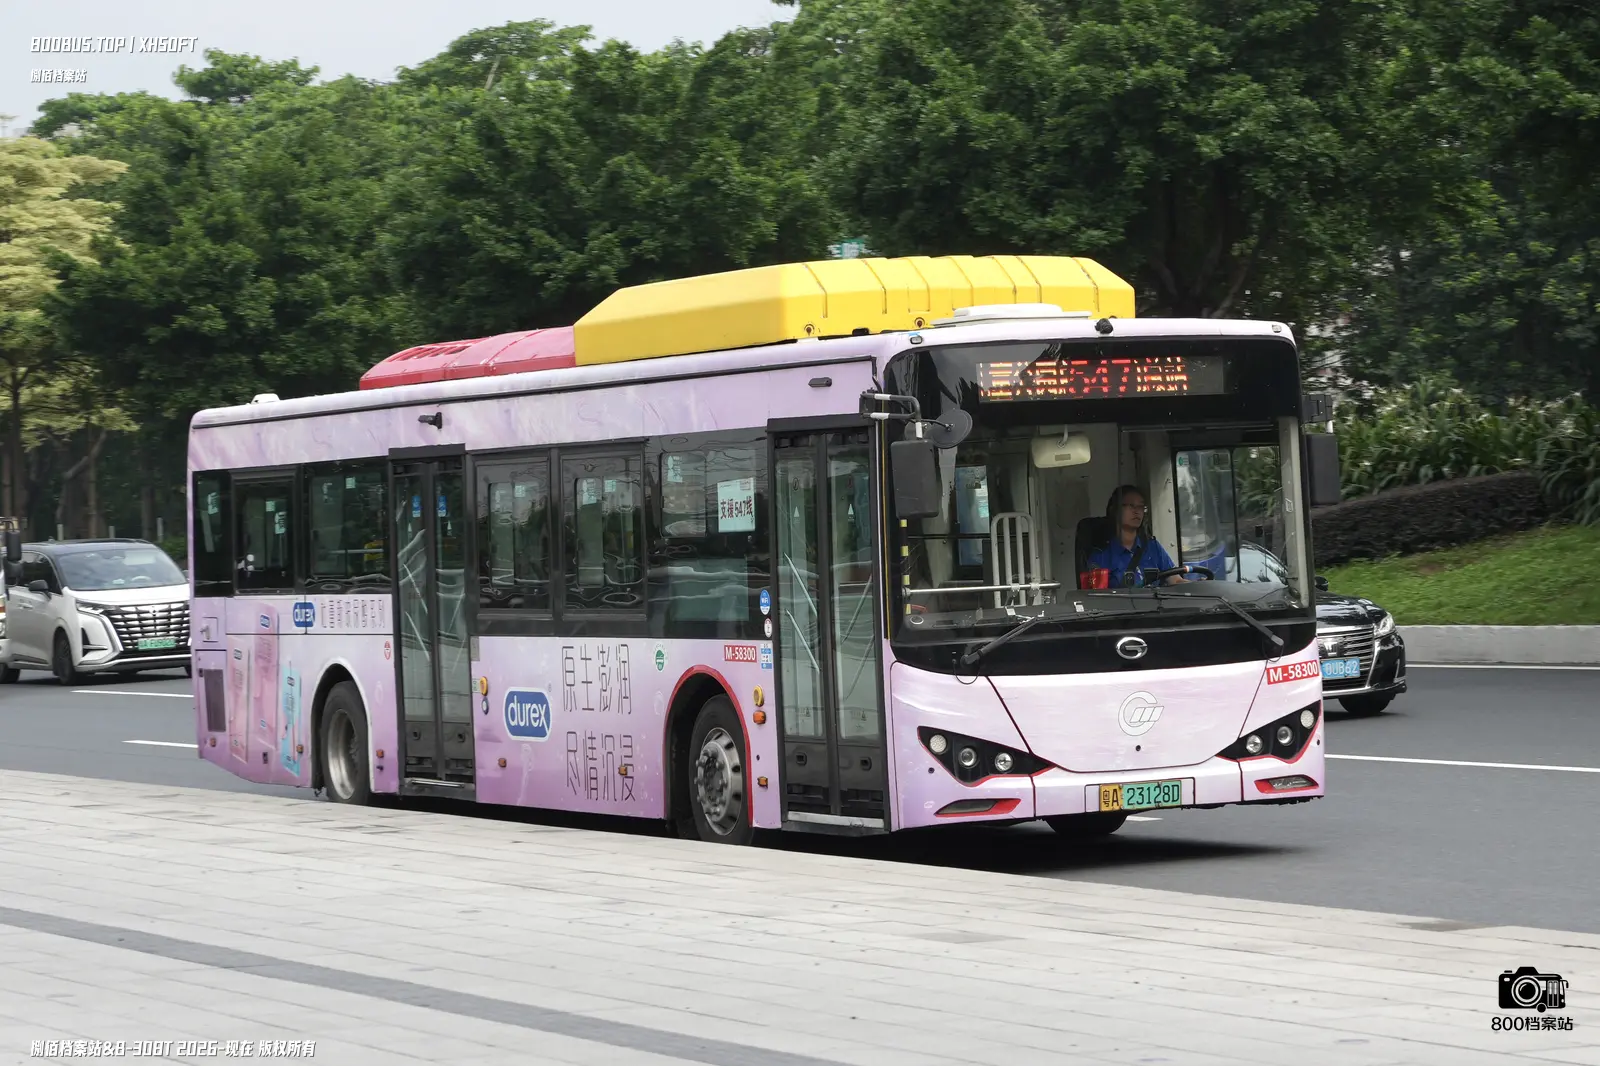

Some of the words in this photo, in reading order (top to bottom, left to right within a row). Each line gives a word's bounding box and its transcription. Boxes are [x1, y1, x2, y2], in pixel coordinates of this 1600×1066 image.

[725, 646, 756, 661] M-58300
[561, 643, 632, 715] 原生澎润
[1269, 661, 1318, 683] M-58300
[507, 695, 550, 734] durex
[566, 730, 636, 802] 尽情沉浸
[1126, 784, 1180, 806] 23128D
